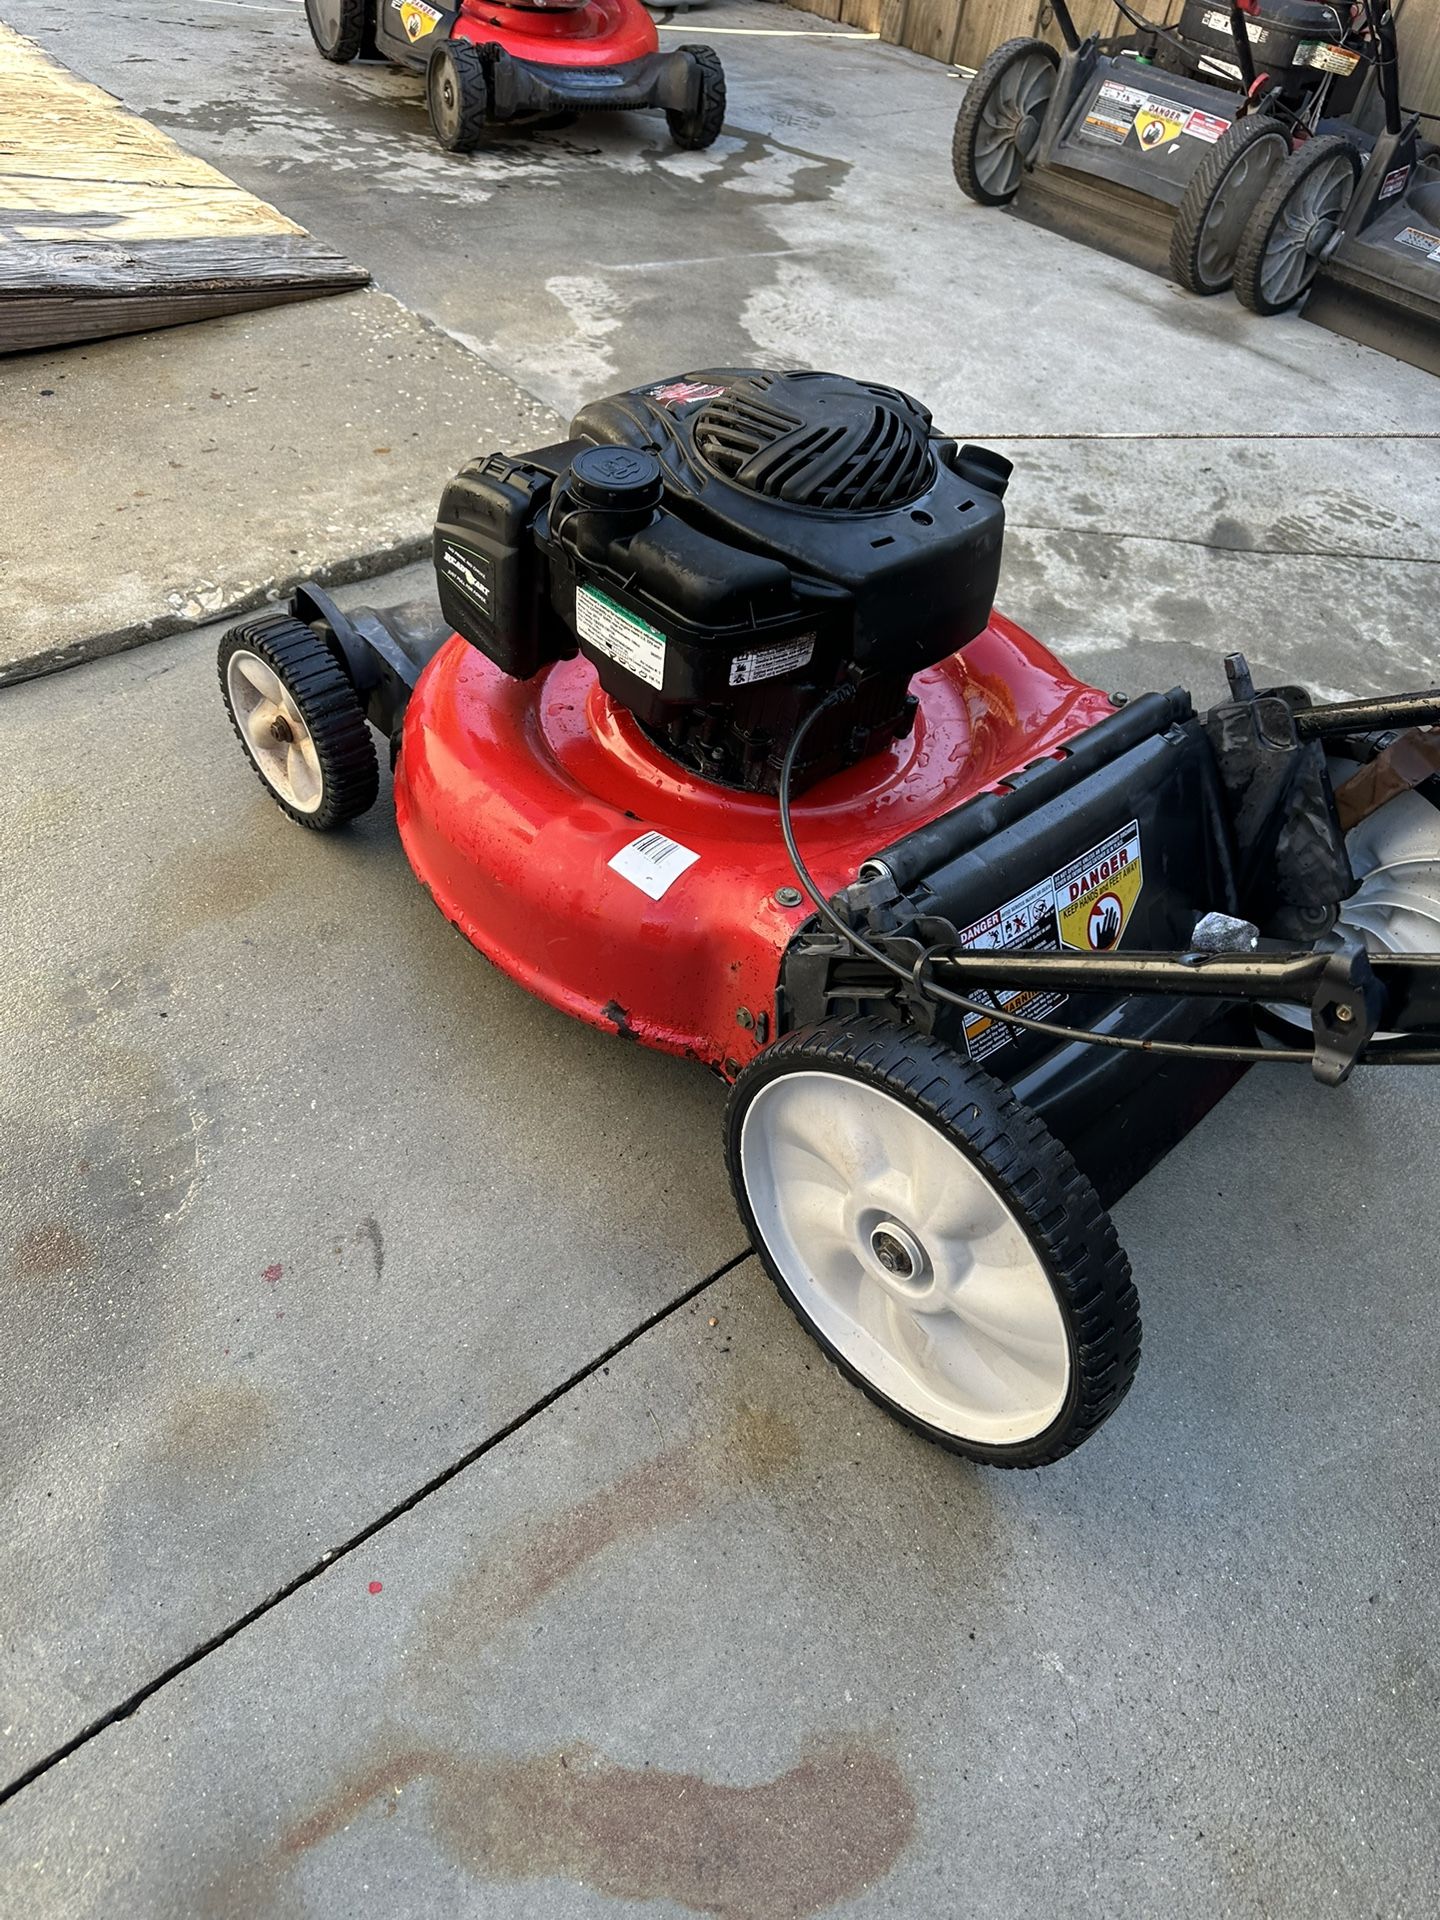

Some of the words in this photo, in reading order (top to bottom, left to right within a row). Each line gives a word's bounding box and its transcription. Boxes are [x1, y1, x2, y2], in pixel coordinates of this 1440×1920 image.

[1148, 104, 1182, 121] DANGER
[1063, 904, 1079, 919] KEEP
[1080, 889, 1098, 909] HANDS
[1099, 881, 1109, 894] and
[1109, 873, 1122, 888] FEET
[1122, 860, 1138, 878] AWAY
[1069, 849, 1129, 902] DANGER
[960, 913, 999, 944] DANGER
